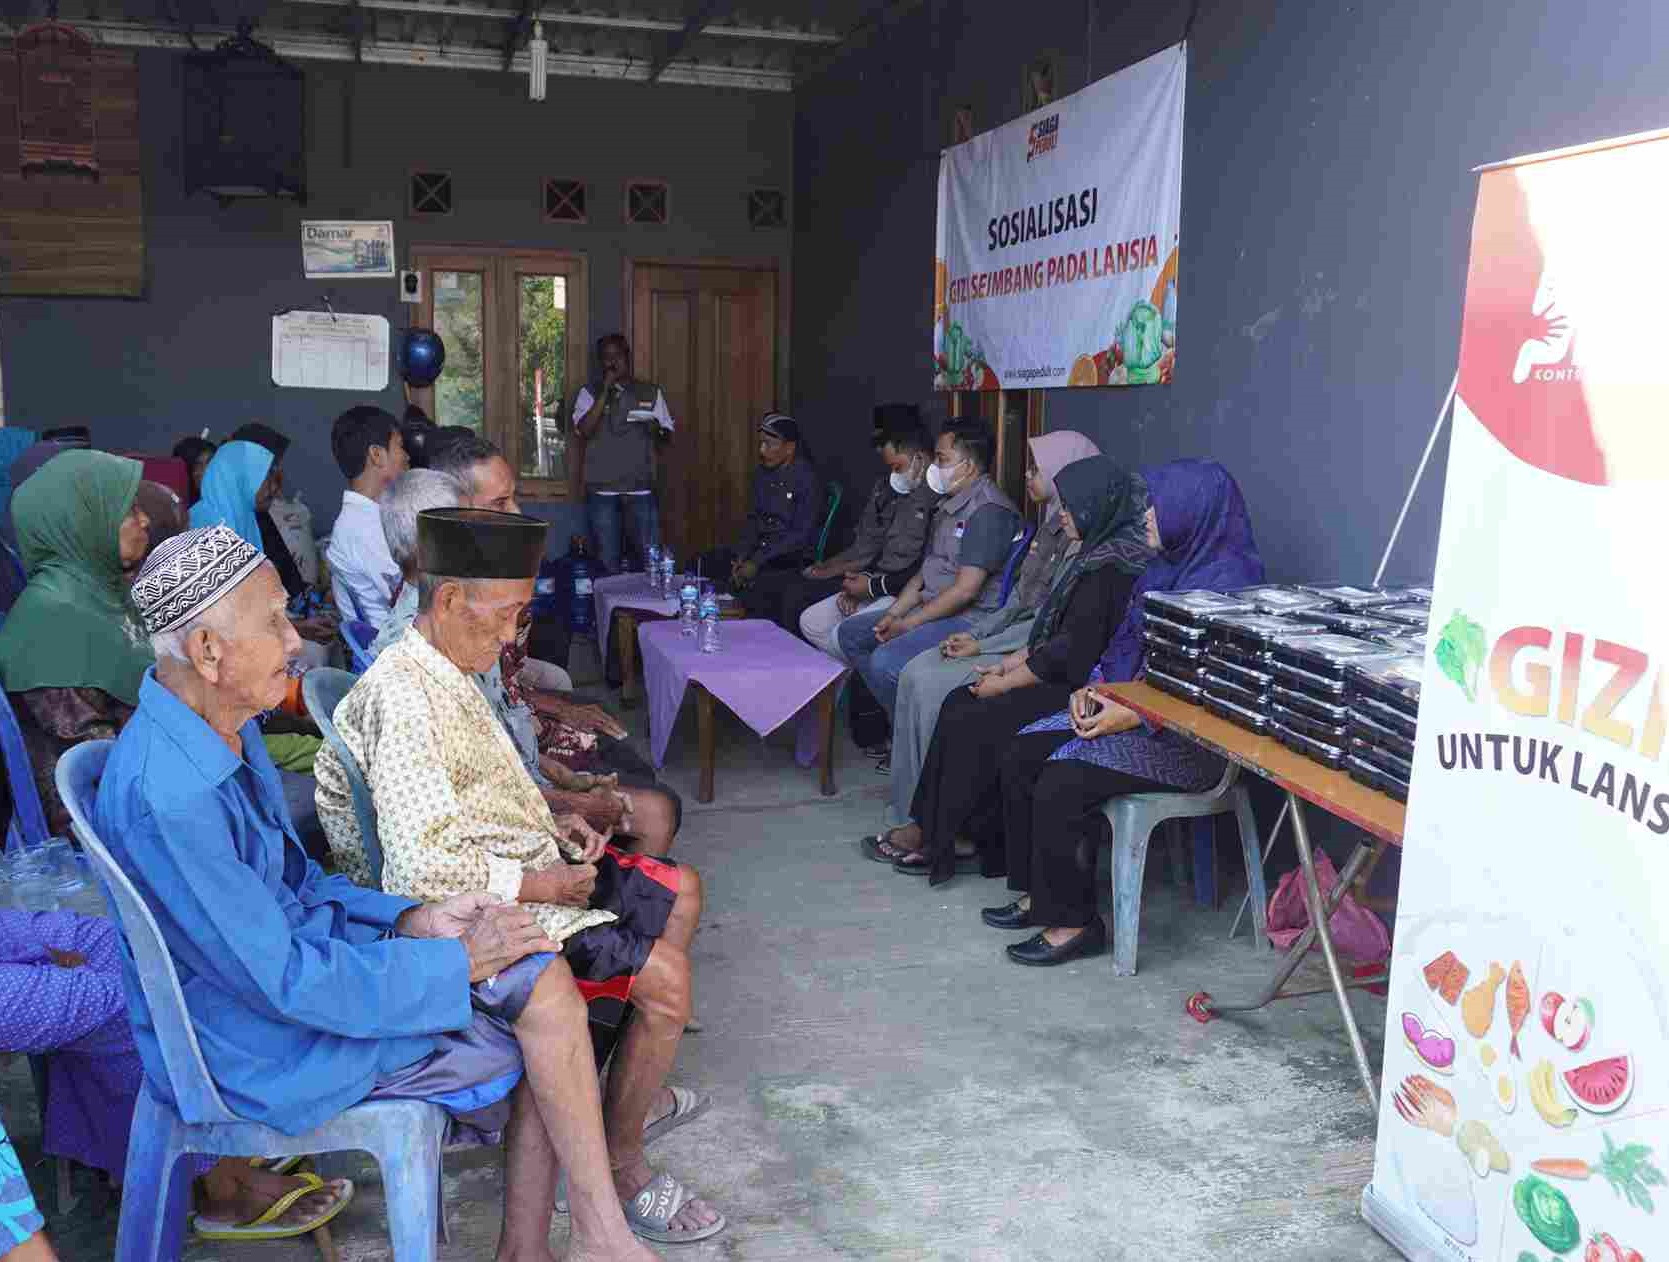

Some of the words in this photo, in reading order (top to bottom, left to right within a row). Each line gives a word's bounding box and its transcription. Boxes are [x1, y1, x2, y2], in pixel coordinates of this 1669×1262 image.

[306, 226, 355, 240] Damar
[987, 187, 1098, 251] SOSIALISASI
[1047, 246, 1088, 287] PADA
[1092, 234, 1159, 278] LANSIA
[1437, 732, 1564, 785] UNTUK
